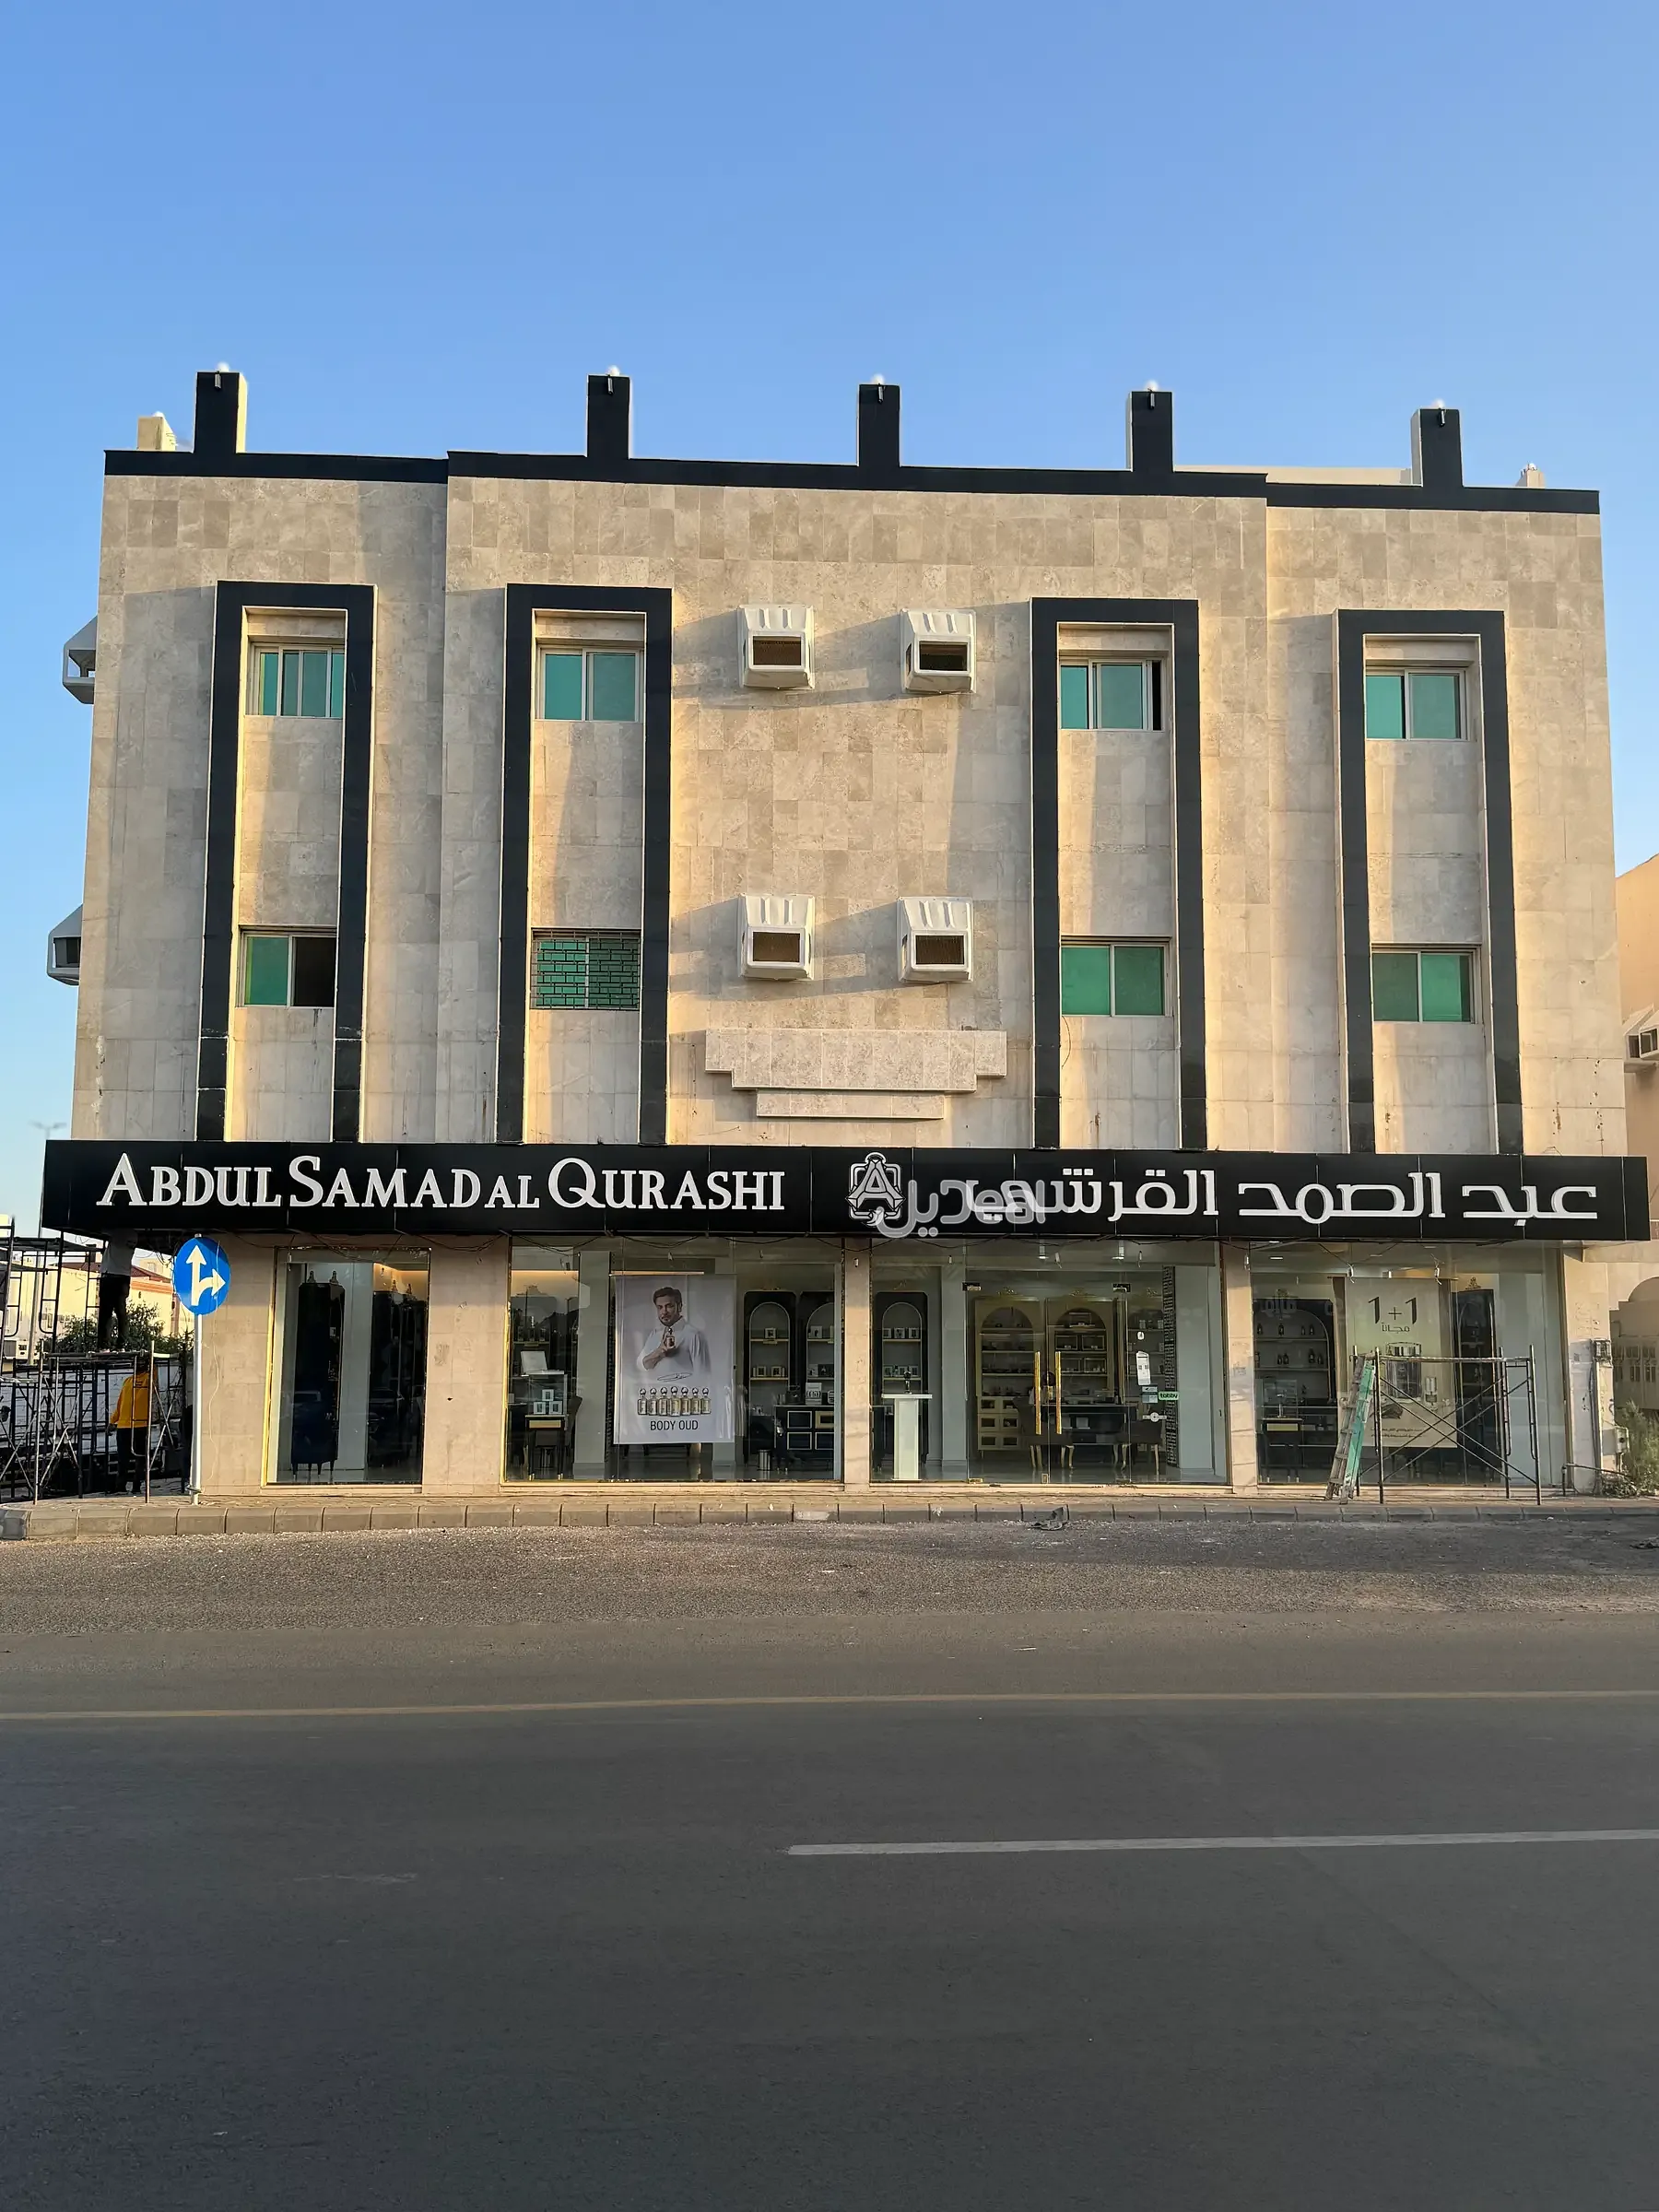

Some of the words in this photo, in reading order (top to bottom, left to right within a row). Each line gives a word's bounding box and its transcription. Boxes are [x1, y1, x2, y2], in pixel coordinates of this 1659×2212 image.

[96, 1152, 281, 1207] ABDUL
[288, 1155, 481, 1209] SAMAD
[484, 1175, 539, 1209] AL
[548, 1157, 785, 1211] QURASHI
[965, 1168, 1218, 1222] القرشي
[1238, 1171, 1445, 1224] الصمد
[1462, 1184, 1597, 1226] عبد
[1368, 1296, 1418, 1324] 1+1
[650, 1420, 676, 1430] BODY
[678, 1419, 699, 1430] OUD
